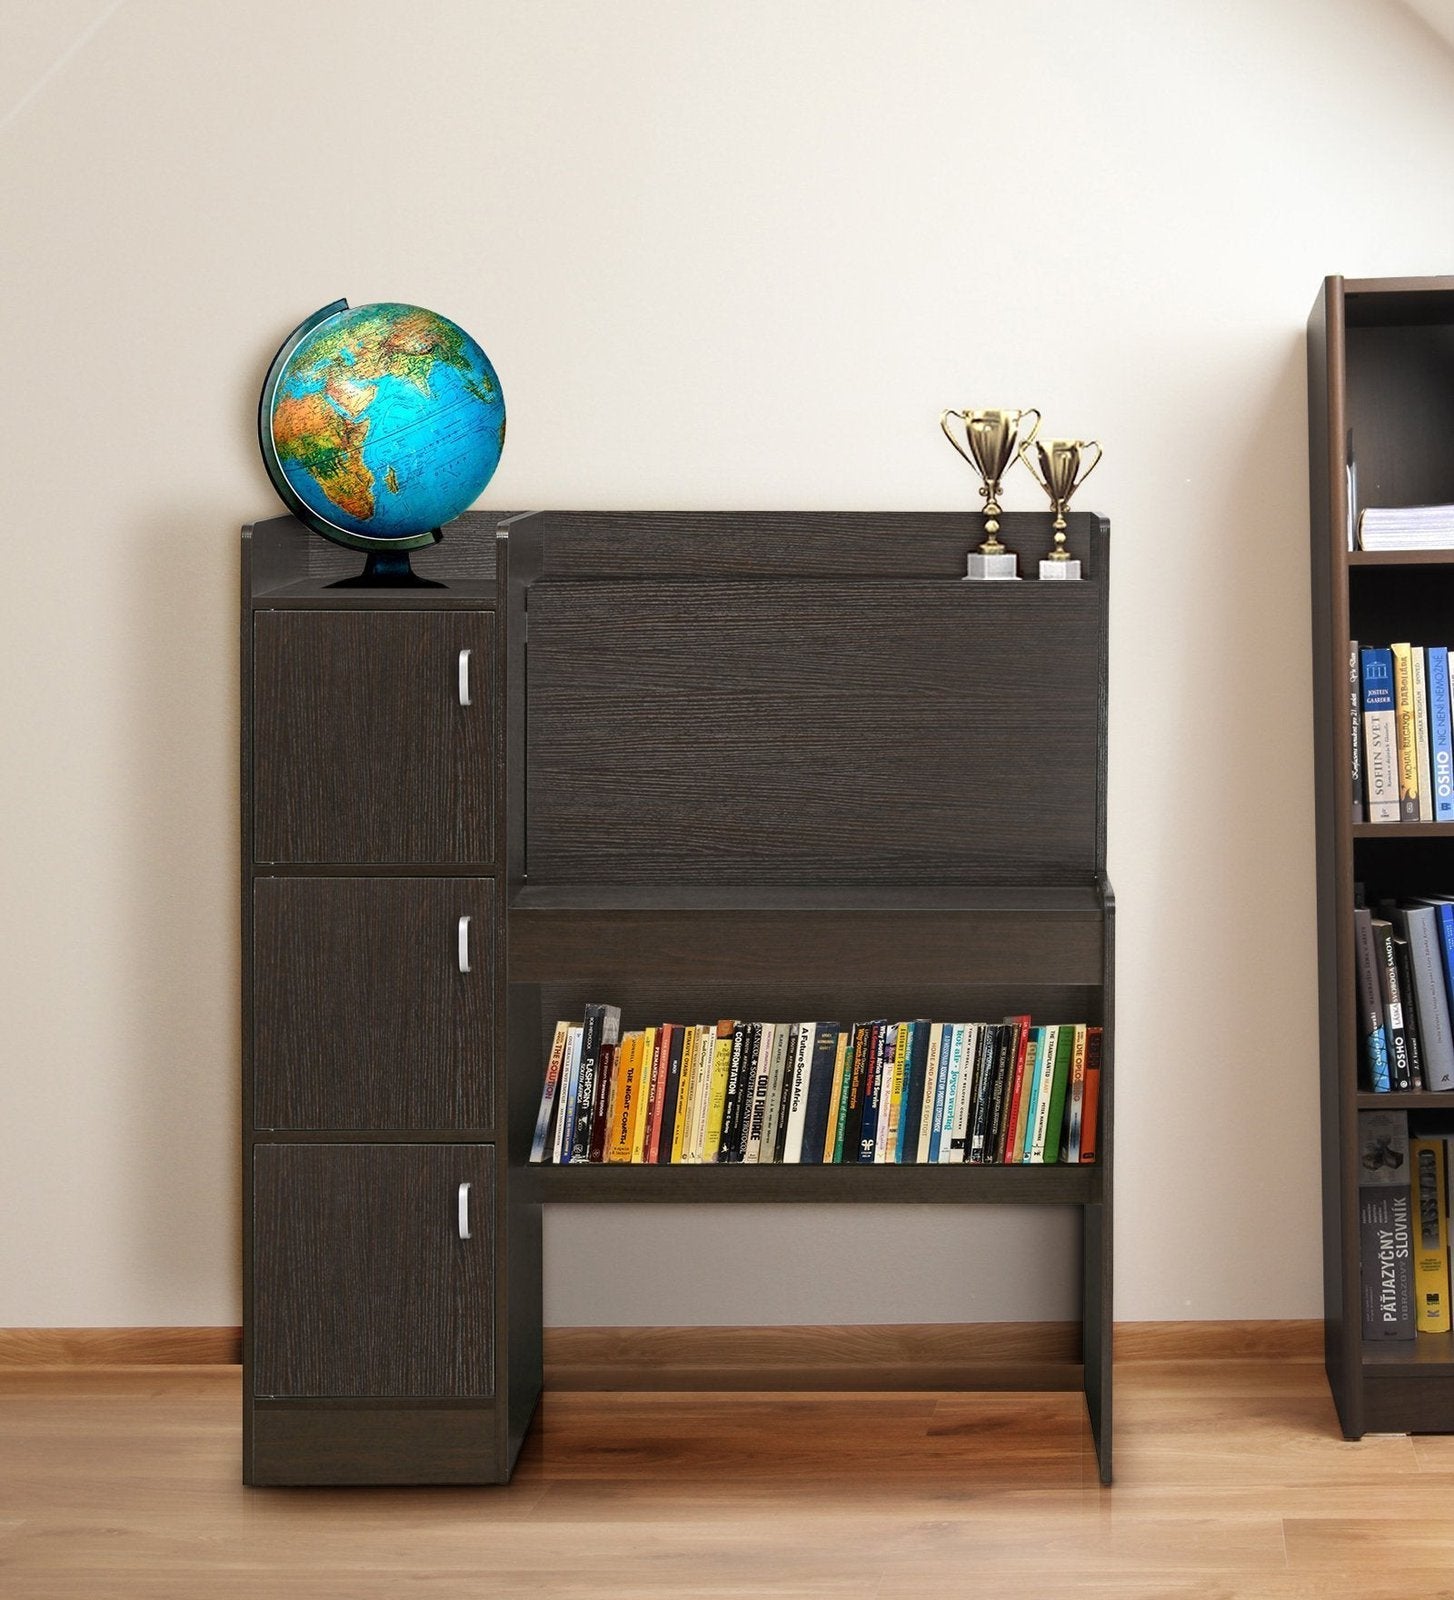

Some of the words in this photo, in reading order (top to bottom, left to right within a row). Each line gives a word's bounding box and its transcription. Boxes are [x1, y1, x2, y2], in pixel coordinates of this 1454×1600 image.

[1366, 696, 1391, 704] GAARDER
[1436, 704, 1446, 726] NENÍ
[1371, 716, 1381, 746] SVET
[1437, 730, 1447, 745] NIC
[1373, 752, 1384, 795] SOFIIN
[1436, 751, 1451, 796] OSHO
[1385, 937, 1394, 966] SAMOTA
[1389, 967, 1398, 1003] SVOBODA
[553, 1045, 562, 1058] THE
[798, 1035, 808, 1061] Future
[855, 1042, 863, 1057] South
[955, 1030, 963, 1046] hot
[1395, 1037, 1406, 1068] OSHO
[652, 1047, 660, 1081] PERMANENT
[728, 1032, 742, 1094] CONFRONTATION
[853, 1058, 861, 1075] Africa
[1045, 1041, 1054, 1077] TRANSPLANTED
[545, 1060, 559, 1099] SOLUTION
[582, 1059, 594, 1109] FLASHPOINT
[748, 1067, 756, 1090] SOUTH
[756, 1075, 768, 1097] COLD
[795, 1063, 804, 1087] South
[948, 1071, 959, 1096] joyce
[623, 1086, 632, 1110] NIGHT
[792, 1088, 801, 1112] Africa
[850, 1088, 858, 1109] survive
[925, 1078, 933, 1104] ABROAD
[619, 1112, 629, 1144] COMETH
[751, 1100, 765, 1140] FURNACE
[944, 1098, 956, 1131] waring
[740, 1121, 749, 1154] PROTOCOL
[1392, 1197, 1409, 1258] SLOVNÍK
[1377, 1229, 1397, 1322] PÄŤJAZYČNÝ
[1400, 1260, 1408, 1320] OBRAZOVÝ
